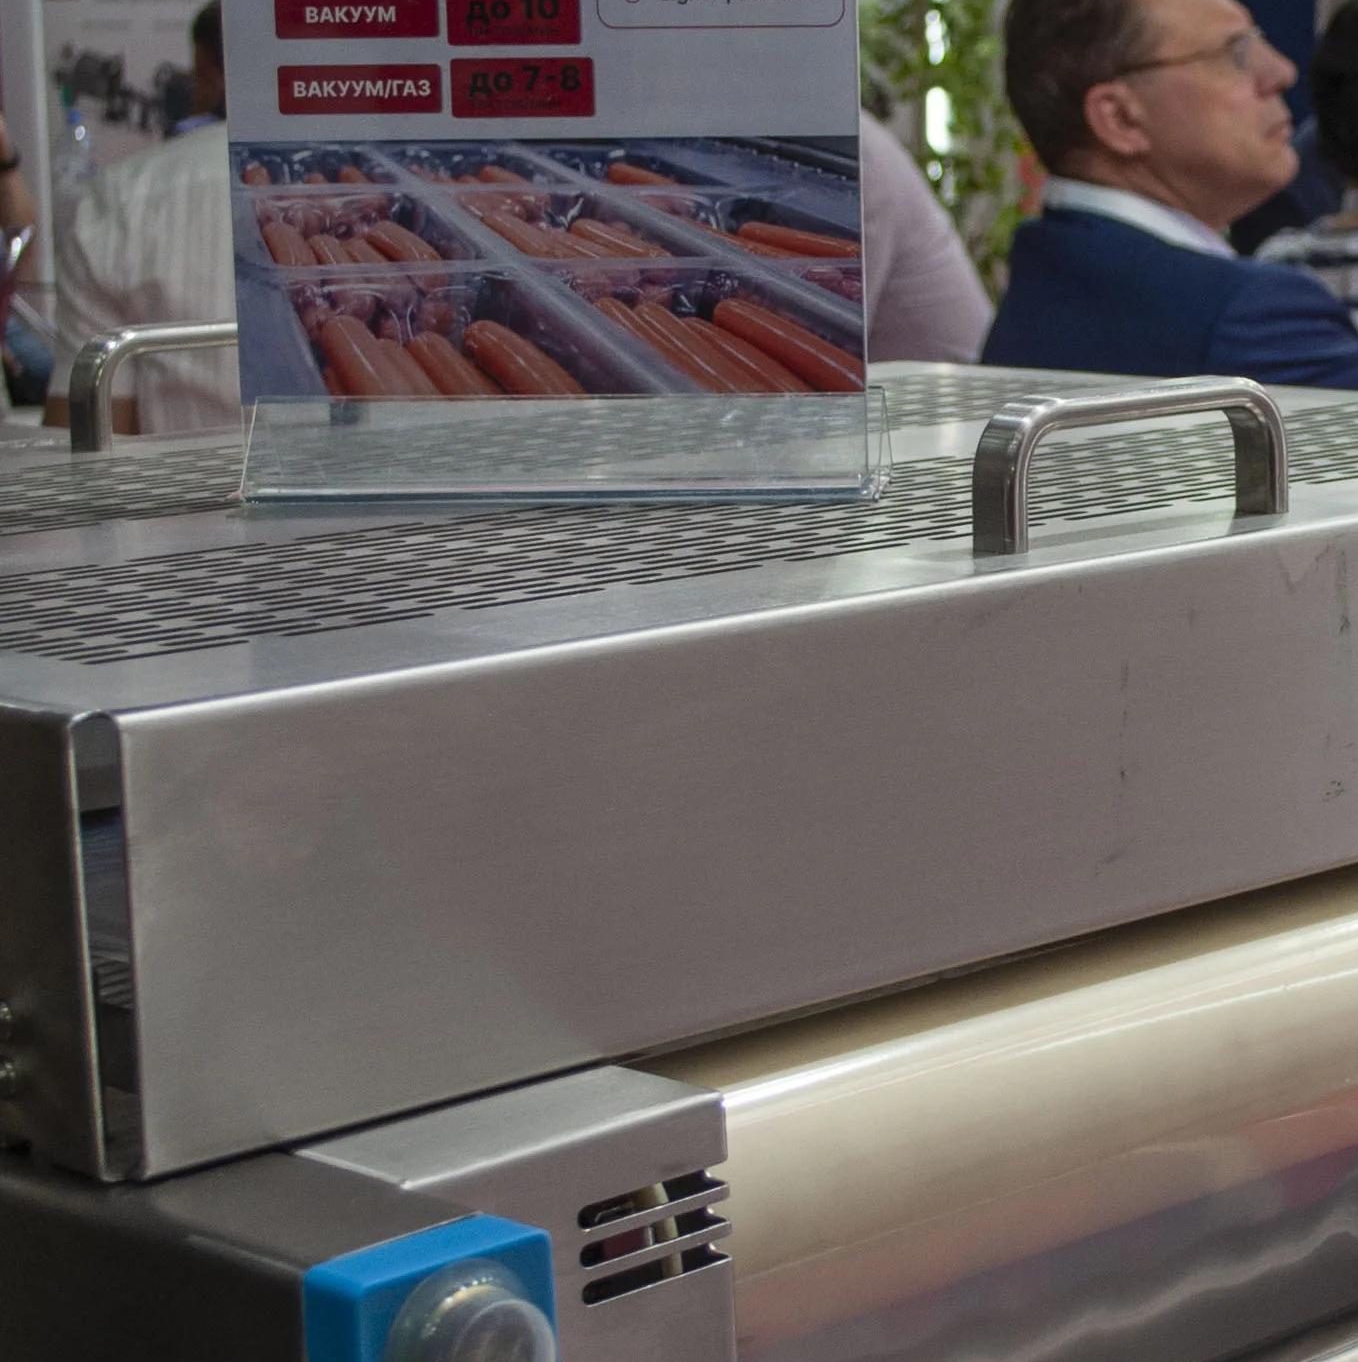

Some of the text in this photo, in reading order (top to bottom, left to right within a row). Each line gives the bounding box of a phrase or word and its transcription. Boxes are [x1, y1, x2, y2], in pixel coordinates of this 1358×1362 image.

[305, 6, 397, 24] ВАКУУМ
[466, 0, 511, 27] до
[293, 80, 432, 99] ВАКУУМ/ГАЗ
[469, 65, 582, 98] до 7-8
